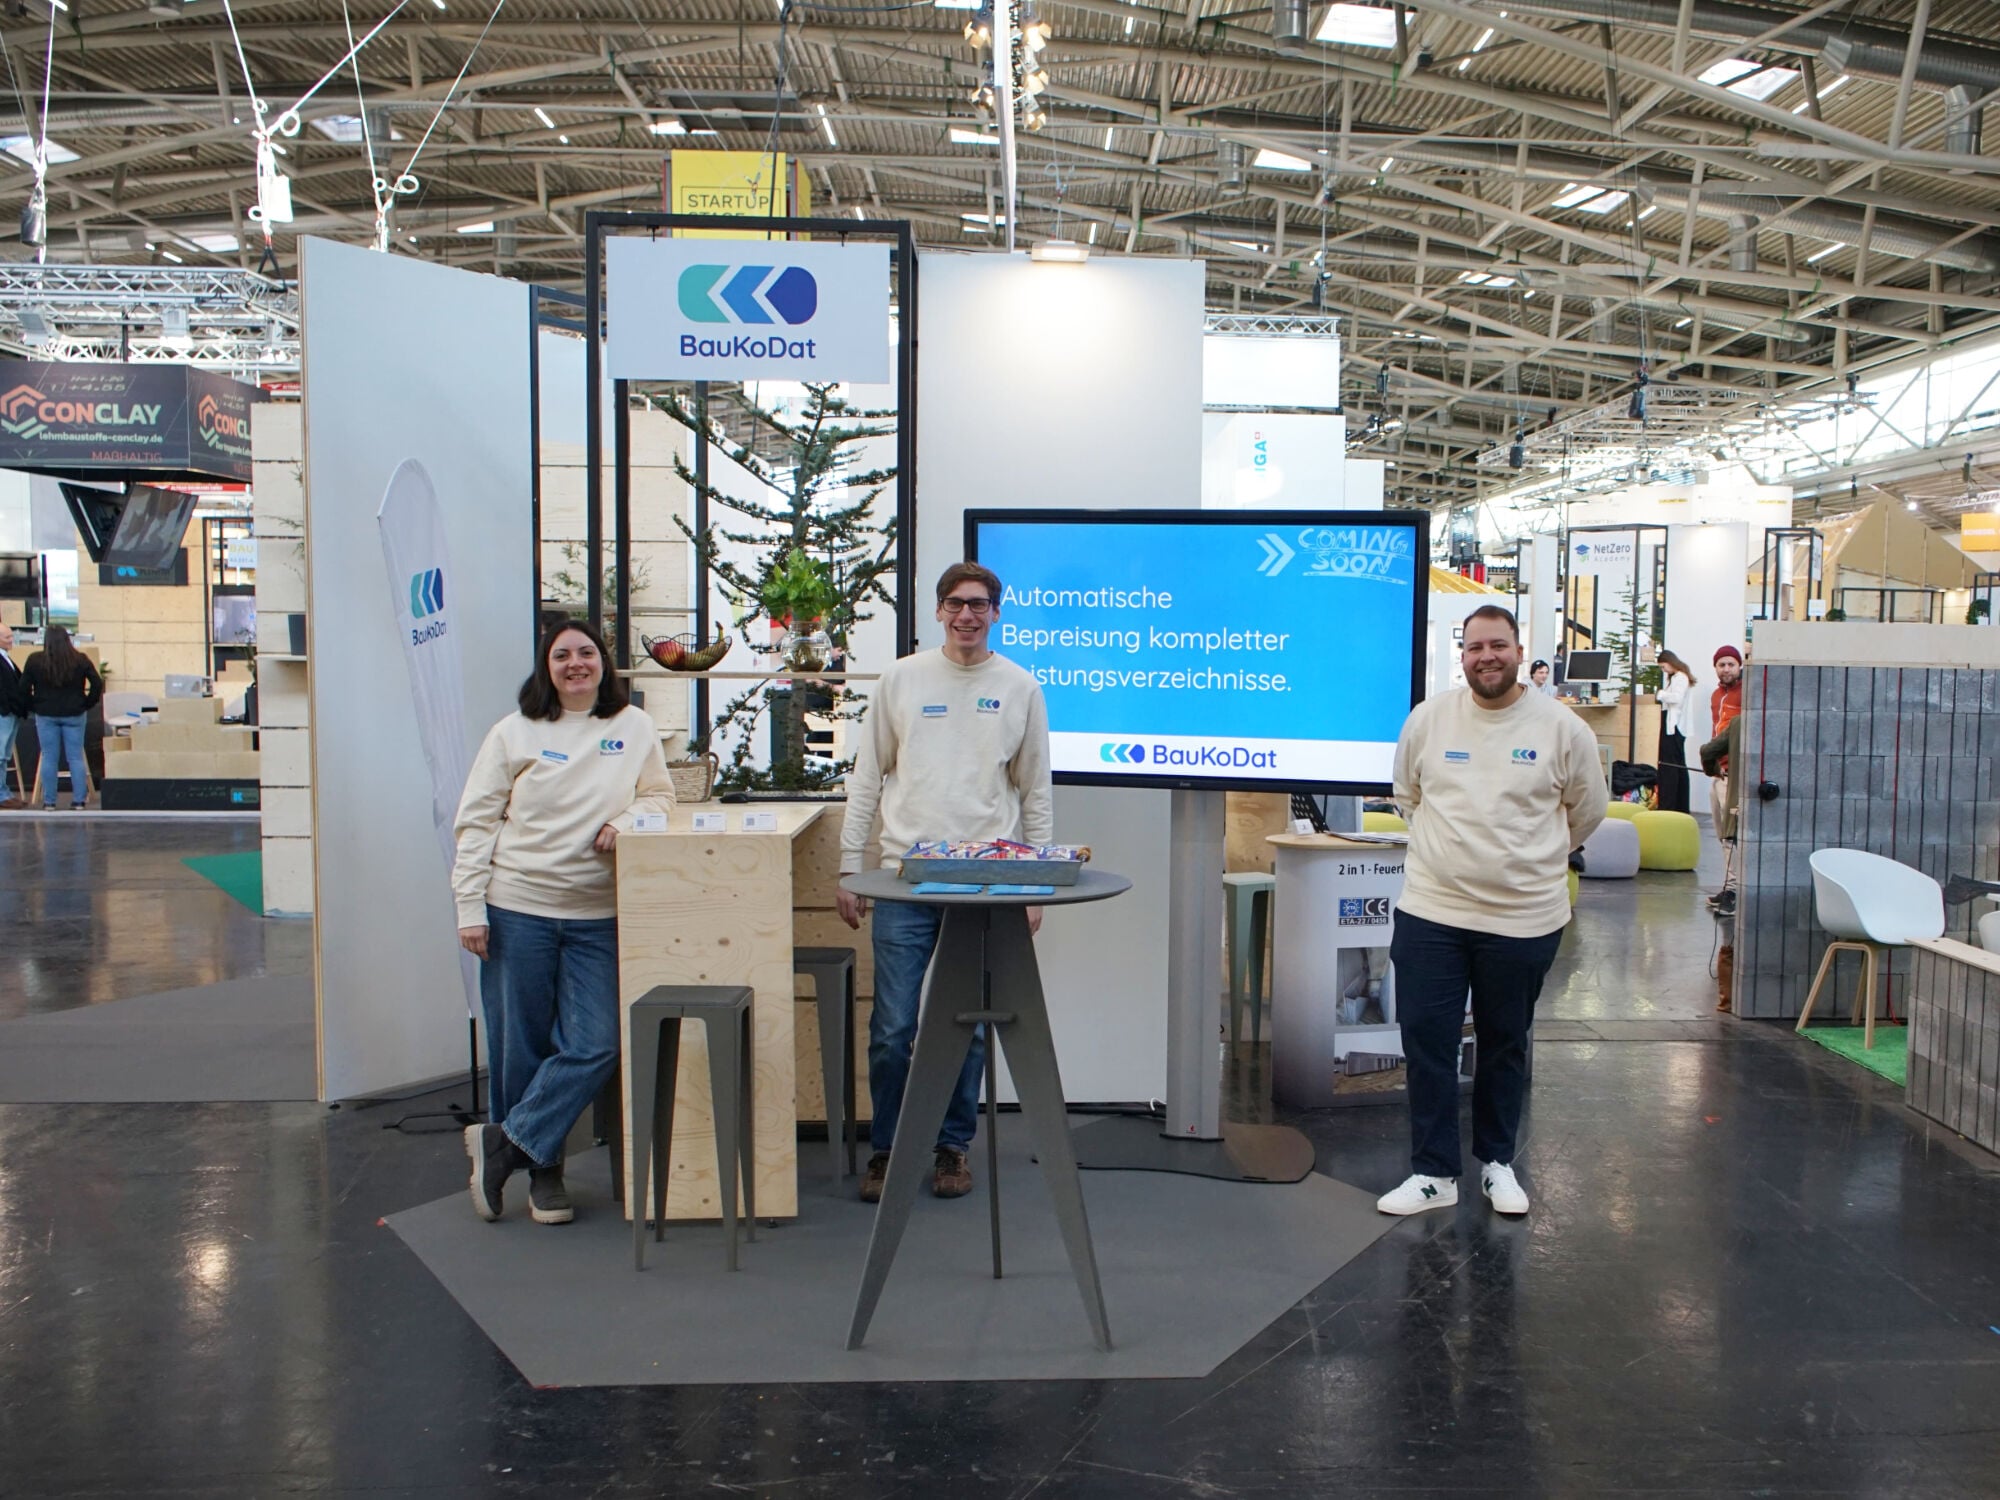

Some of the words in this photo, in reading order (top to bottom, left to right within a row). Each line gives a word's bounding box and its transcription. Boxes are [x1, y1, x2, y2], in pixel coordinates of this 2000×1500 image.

[688, 193, 769, 209] STARTUP
[680, 334, 816, 359] BauKoDat
[38, 401, 161, 425] CONCLAY
[39, 431, 163, 444] lehmbaustoffe-conclay.de
[214, 412, 251, 440] CONCL
[1298, 528, 1409, 554] COMING
[1594, 543, 1631, 554] NetZero
[1311, 551, 1394, 574] SOON
[1001, 584, 1173, 608] Automatische
[1002, 624, 1140, 654] Bepreisung
[1149, 625, 1290, 655] kompletter
[1030, 664, 1292, 692] istungsverzeichnisse.
[1153, 744, 1277, 768] BauKoDat
[1339, 864, 1345, 875] 2
[1347, 864, 1357, 875] in
[1360, 864, 1365, 875] 1
